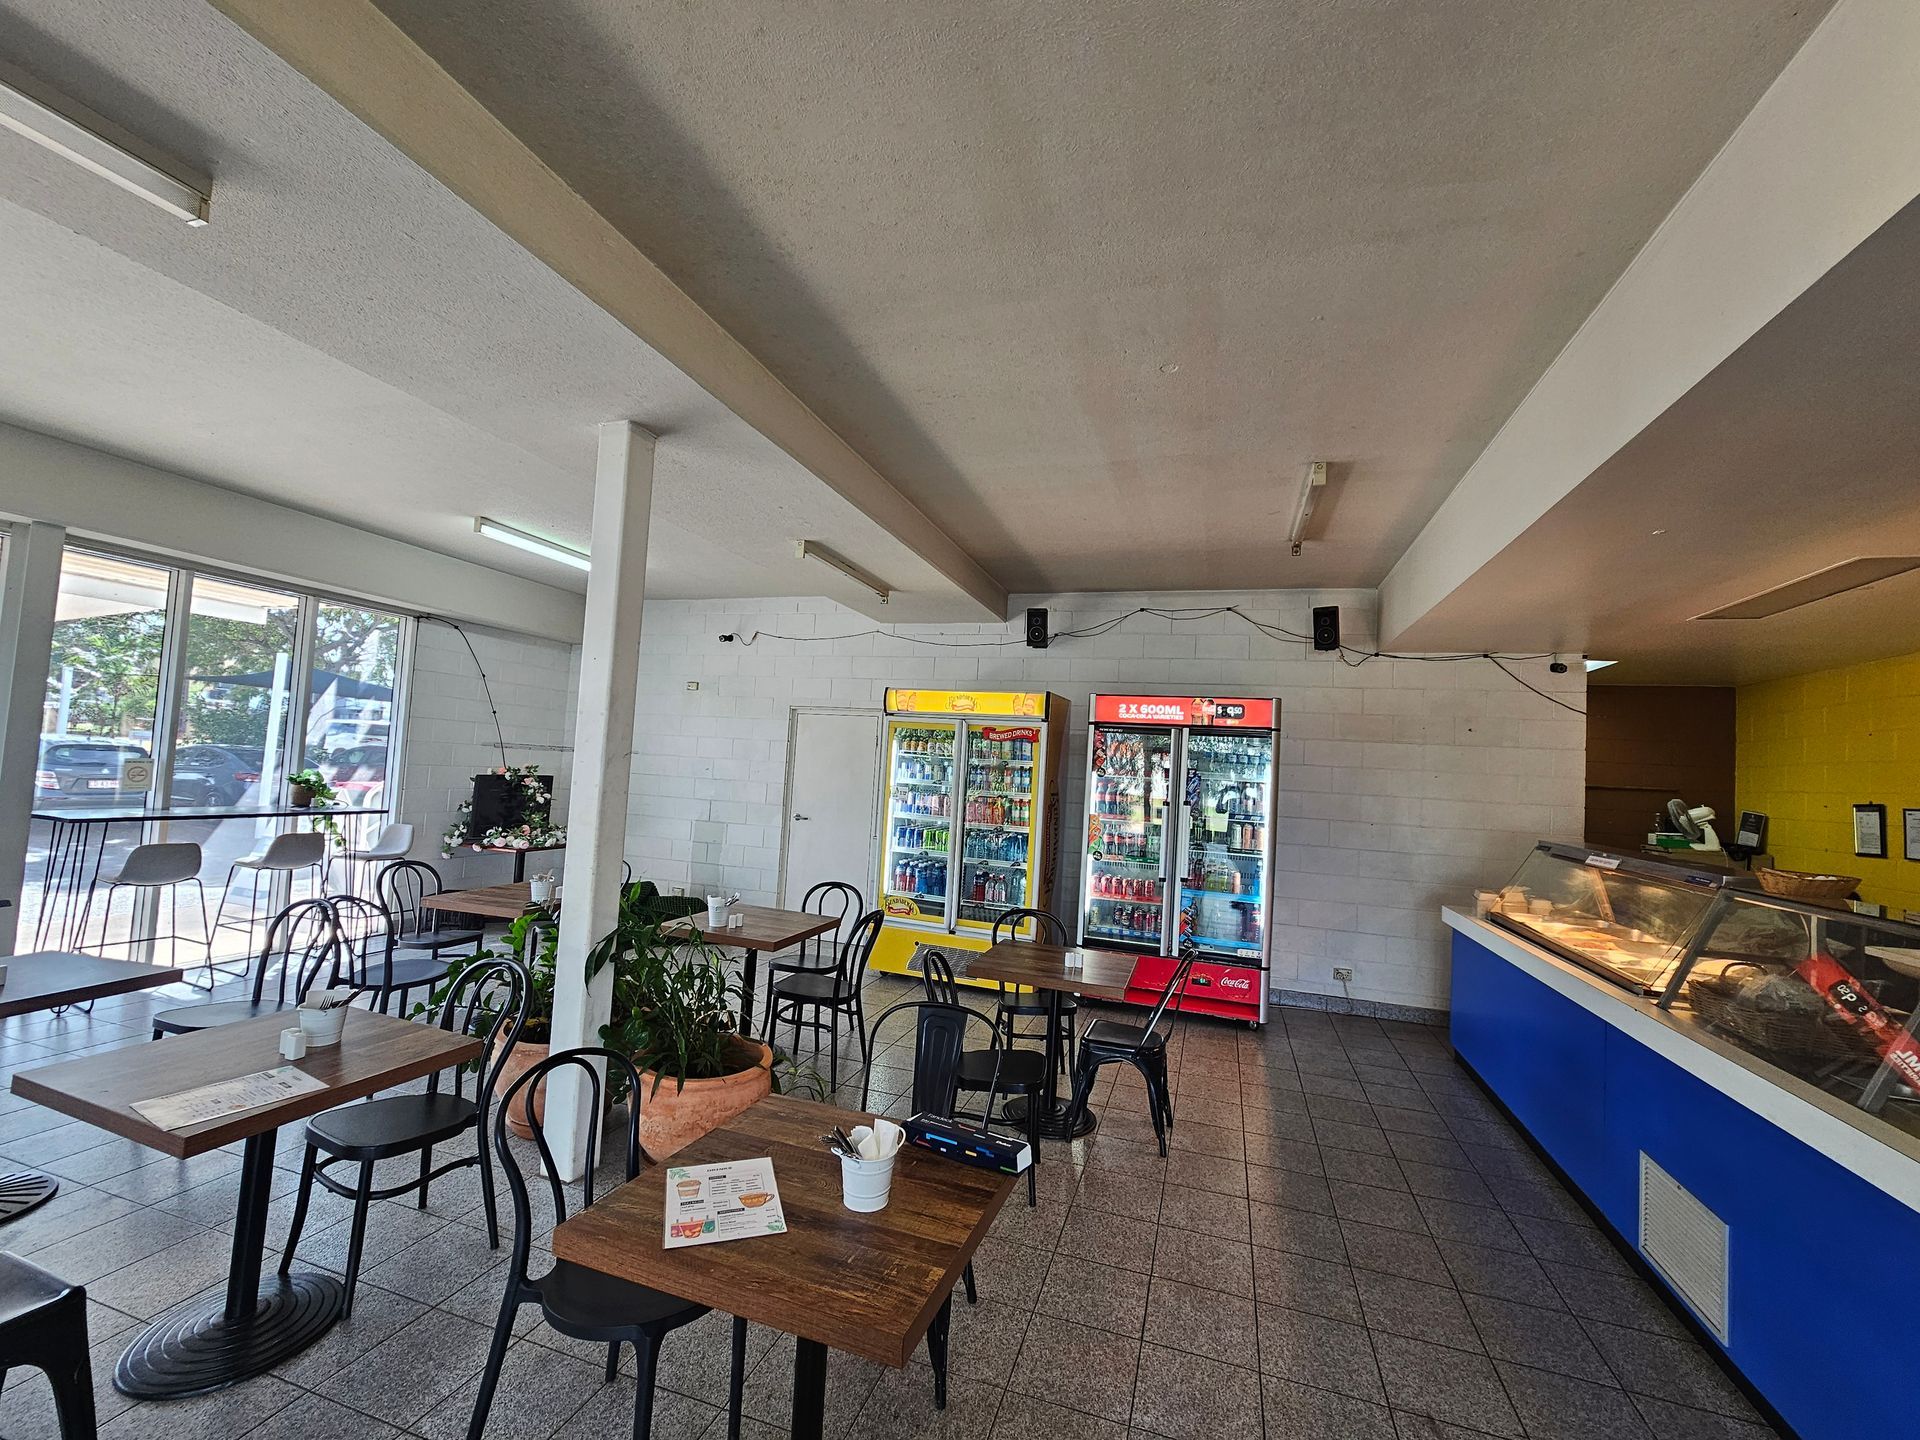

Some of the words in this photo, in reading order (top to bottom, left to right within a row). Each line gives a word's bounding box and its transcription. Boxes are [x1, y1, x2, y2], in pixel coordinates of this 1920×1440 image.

[1119, 704, 1126, 713] 2
[1129, 704, 1138, 713] X
[1140, 704, 1184, 714] 600ML
[989, 732, 1012, 740] BREWED
[1012, 729, 1033, 737] DRINKS
